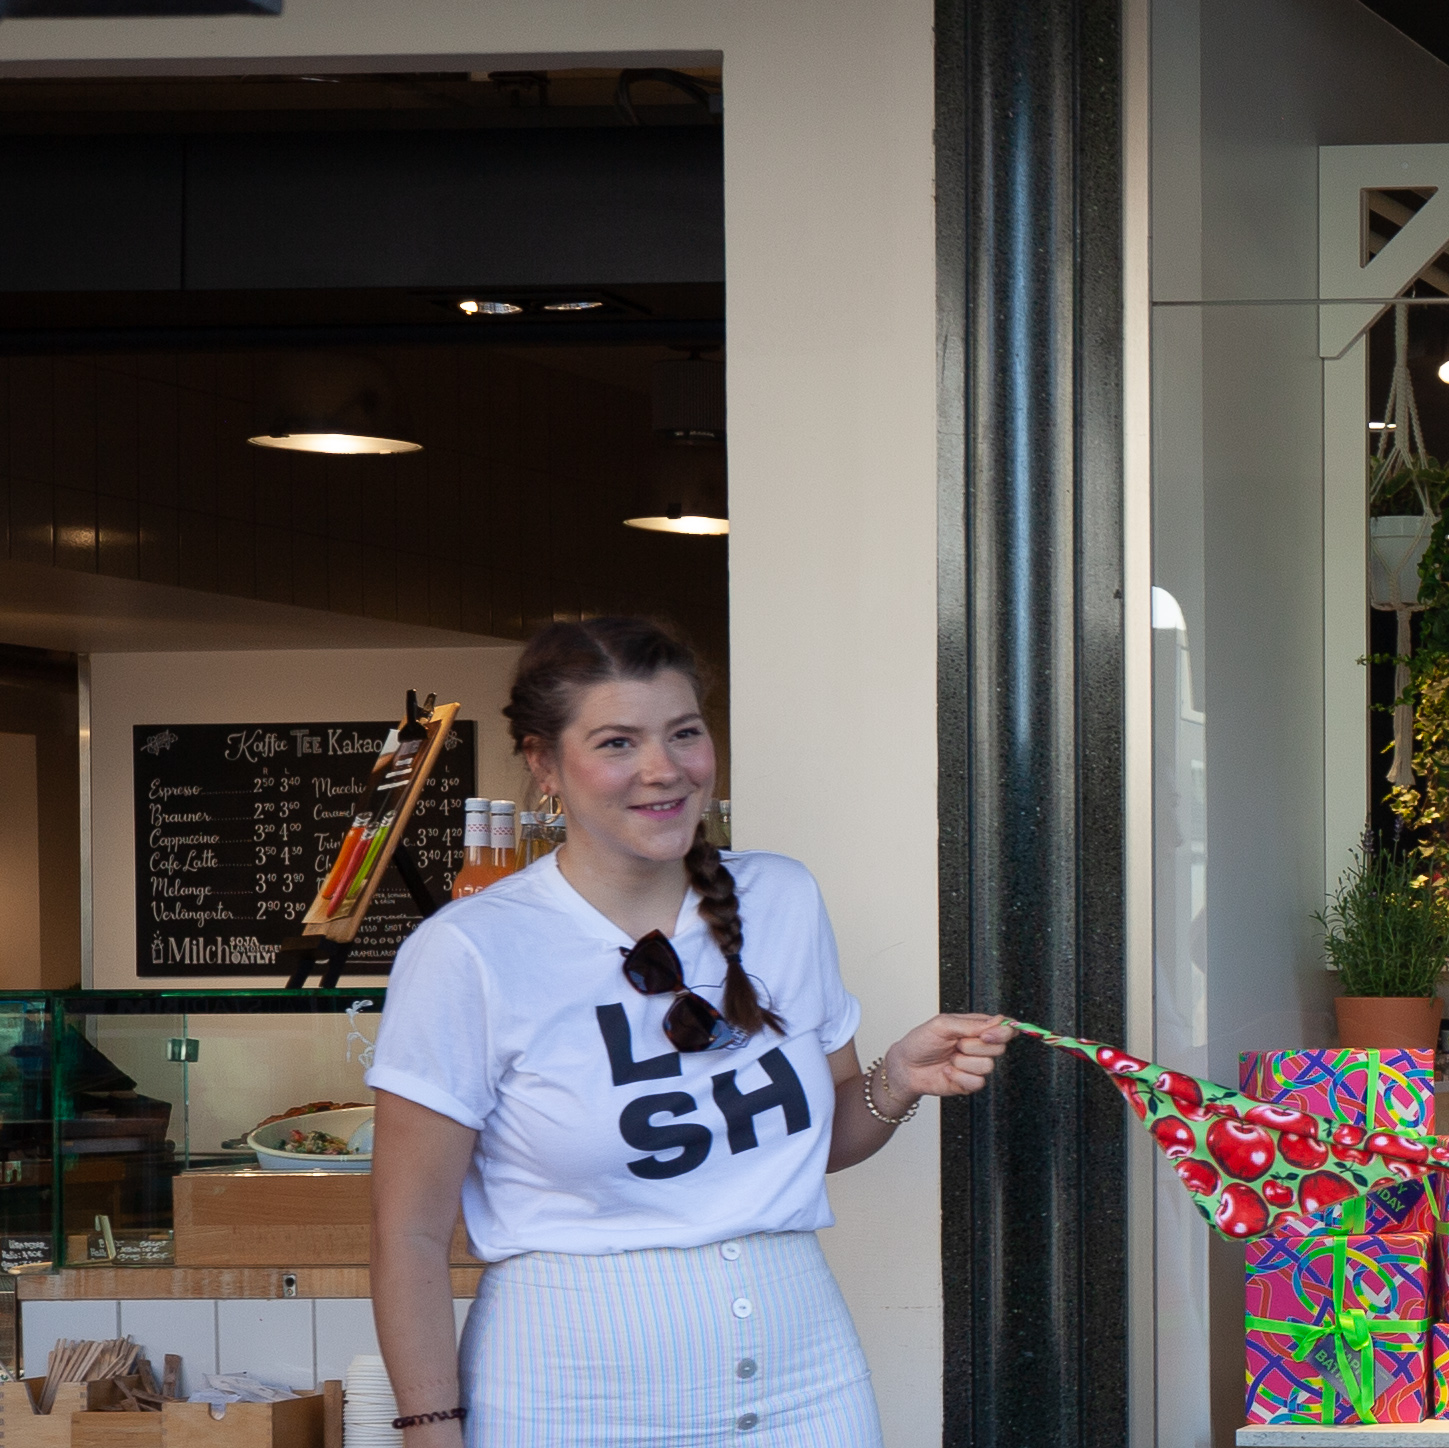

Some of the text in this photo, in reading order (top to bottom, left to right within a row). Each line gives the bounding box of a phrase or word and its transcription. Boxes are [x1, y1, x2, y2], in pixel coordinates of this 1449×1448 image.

[225, 729, 383, 762] Kaffee TEE Kakao
[149, 778, 202, 801] Espresso
[312, 777, 366, 798] Macchi
[149, 803, 212, 826] Brauner
[150, 828, 220, 852] Cappuccino
[150, 852, 182, 875] Cafe
[183, 850, 218, 871] Latte
[151, 876, 213, 905] Melange
[151, 901, 234, 928] Verlängerter
[167, 936, 230, 964] Milch
[229, 936, 259, 946] SOJA
[230, 952, 276, 964] OATLY!
